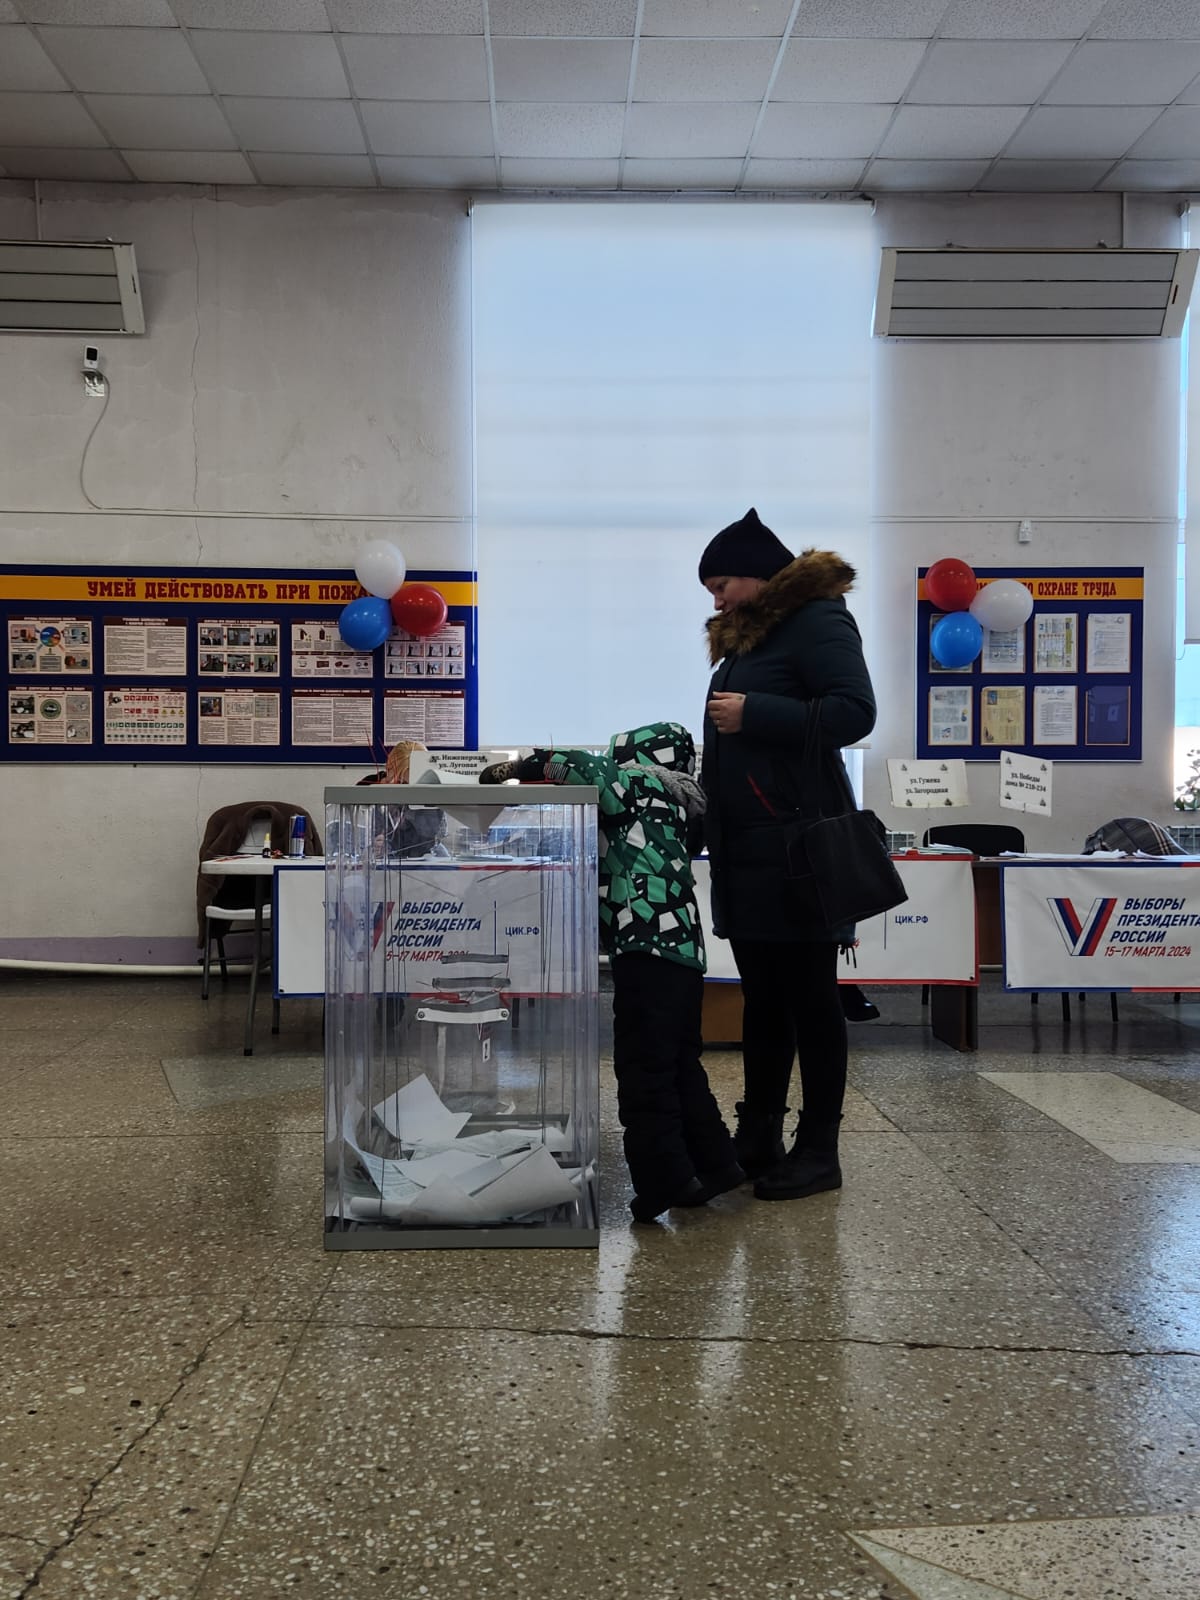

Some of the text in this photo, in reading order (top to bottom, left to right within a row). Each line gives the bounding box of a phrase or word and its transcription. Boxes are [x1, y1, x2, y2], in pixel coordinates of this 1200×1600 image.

[87, 578, 368, 600] УМЕЙ ДЕЙСТВОВАТЬ ПРИ ПОЖА
[1038, 582, 1078, 596] ОХРАНЕ
[1082, 582, 1117, 598] ТРУДА
[1019, 772, 1040, 783] Победы
[402, 901, 464, 914] ВЫБОРЫ
[1123, 897, 1186, 910] ВЫБОРЫ
[394, 918, 482, 932] ПРЕЗИДЕНТА
[894, 915, 929, 925] ЦИК.РФ
[1117, 914, 1200, 928] ПРЕЗИДЕНТА
[505, 926, 540, 937] ЦИК.РФ
[1110, 930, 1167, 943] РОССИИ
[387, 934, 444, 948] РОССИИ
[410, 950, 444, 962] МАРТА
[1132, 945, 1166, 957] МАРТА
[1167, 945, 1191, 957] 2024
